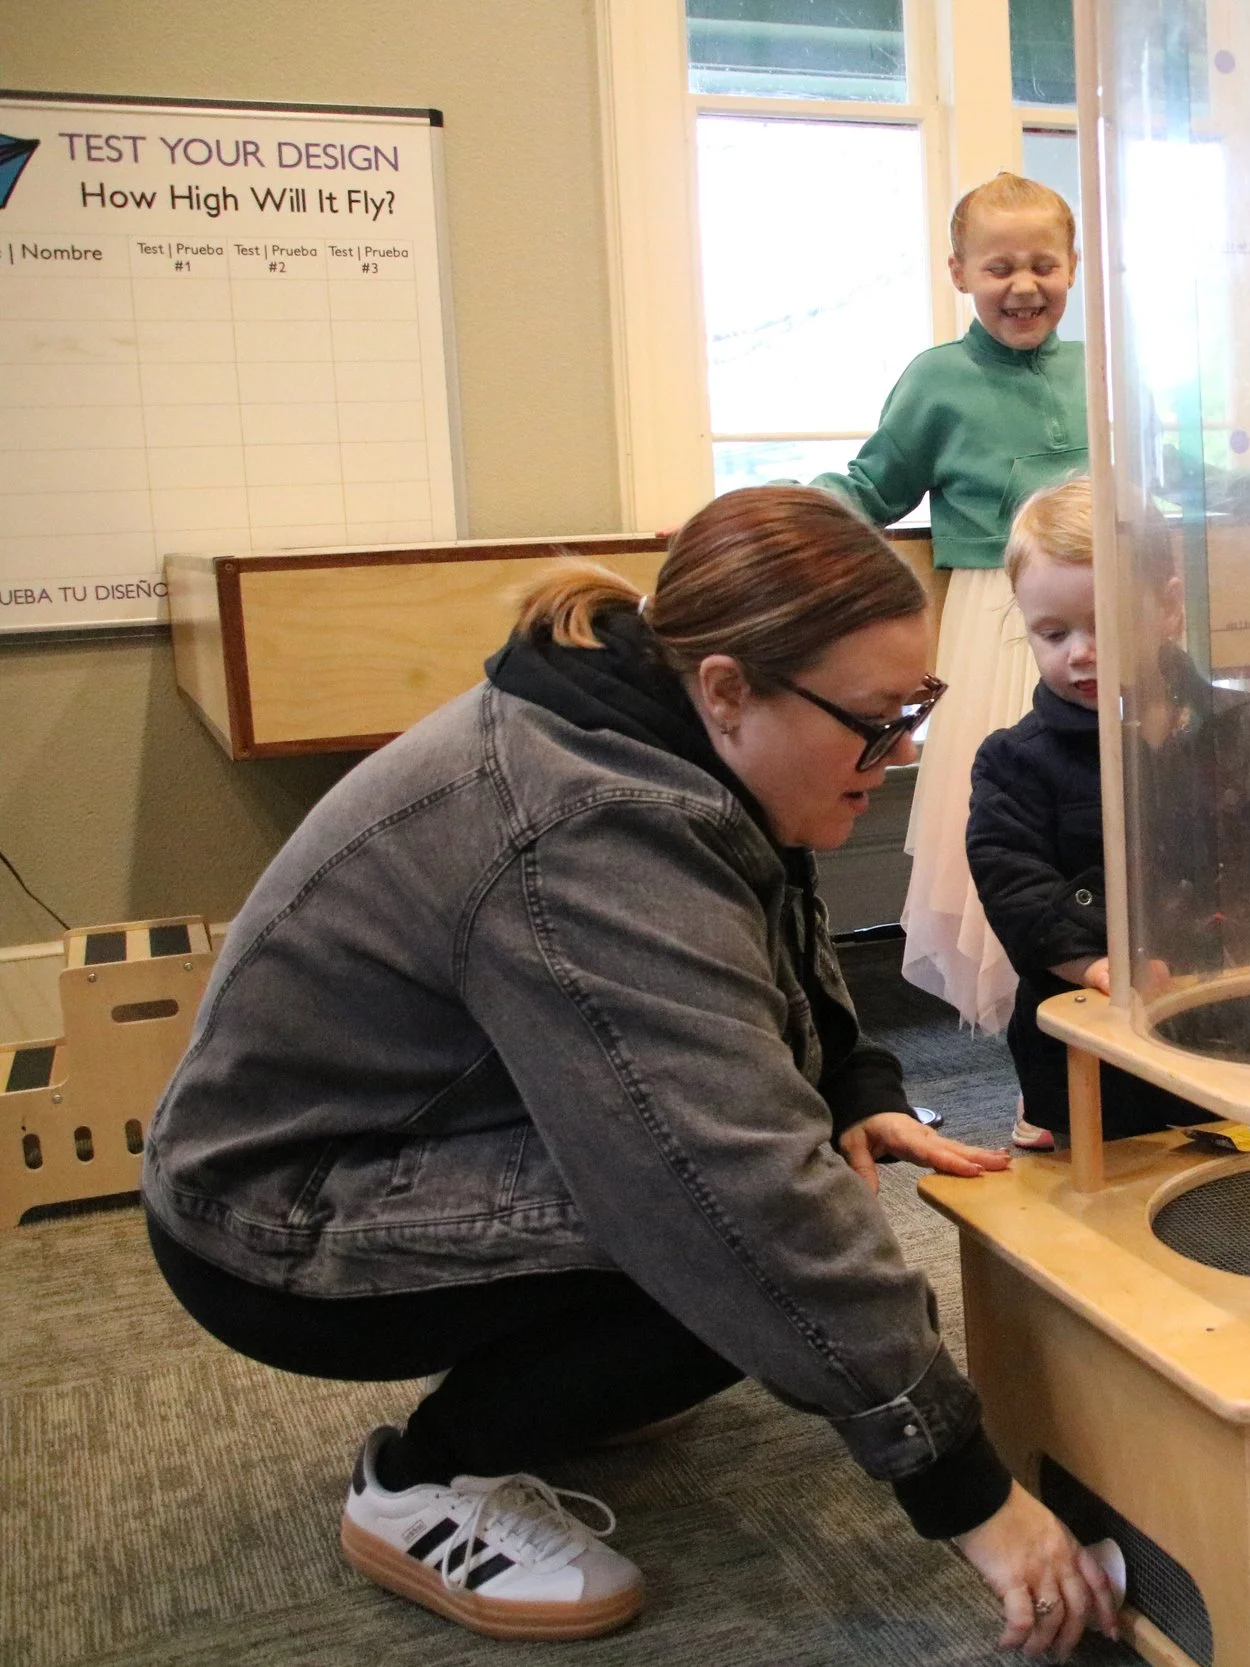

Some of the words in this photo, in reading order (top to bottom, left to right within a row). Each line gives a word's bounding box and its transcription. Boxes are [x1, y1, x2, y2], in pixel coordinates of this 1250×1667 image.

[58, 133, 147, 163] TEST
[159, 137, 266, 168] YOUR
[277, 142, 399, 172] DESIGN
[81, 182, 157, 209] How
[170, 185, 239, 218] High
[250, 187, 307, 213] Will
[318, 189, 339, 214] It
[347, 190, 395, 222] Fly?
[21, 243, 103, 261] Nombre
[137, 242, 164, 255] Test
[176, 243, 224, 256] Prueba
[234, 244, 261, 256] Test
[272, 245, 318, 257] Prueba
[328, 246, 354, 257] Test
[365, 246, 409, 258] Prueba
[174, 261, 191, 272] #1
[269, 262, 287, 273] #2
[361, 263, 379, 274] #3
[58, 586, 87, 602] TU
[95, 580, 169, 600] DISEÑO
